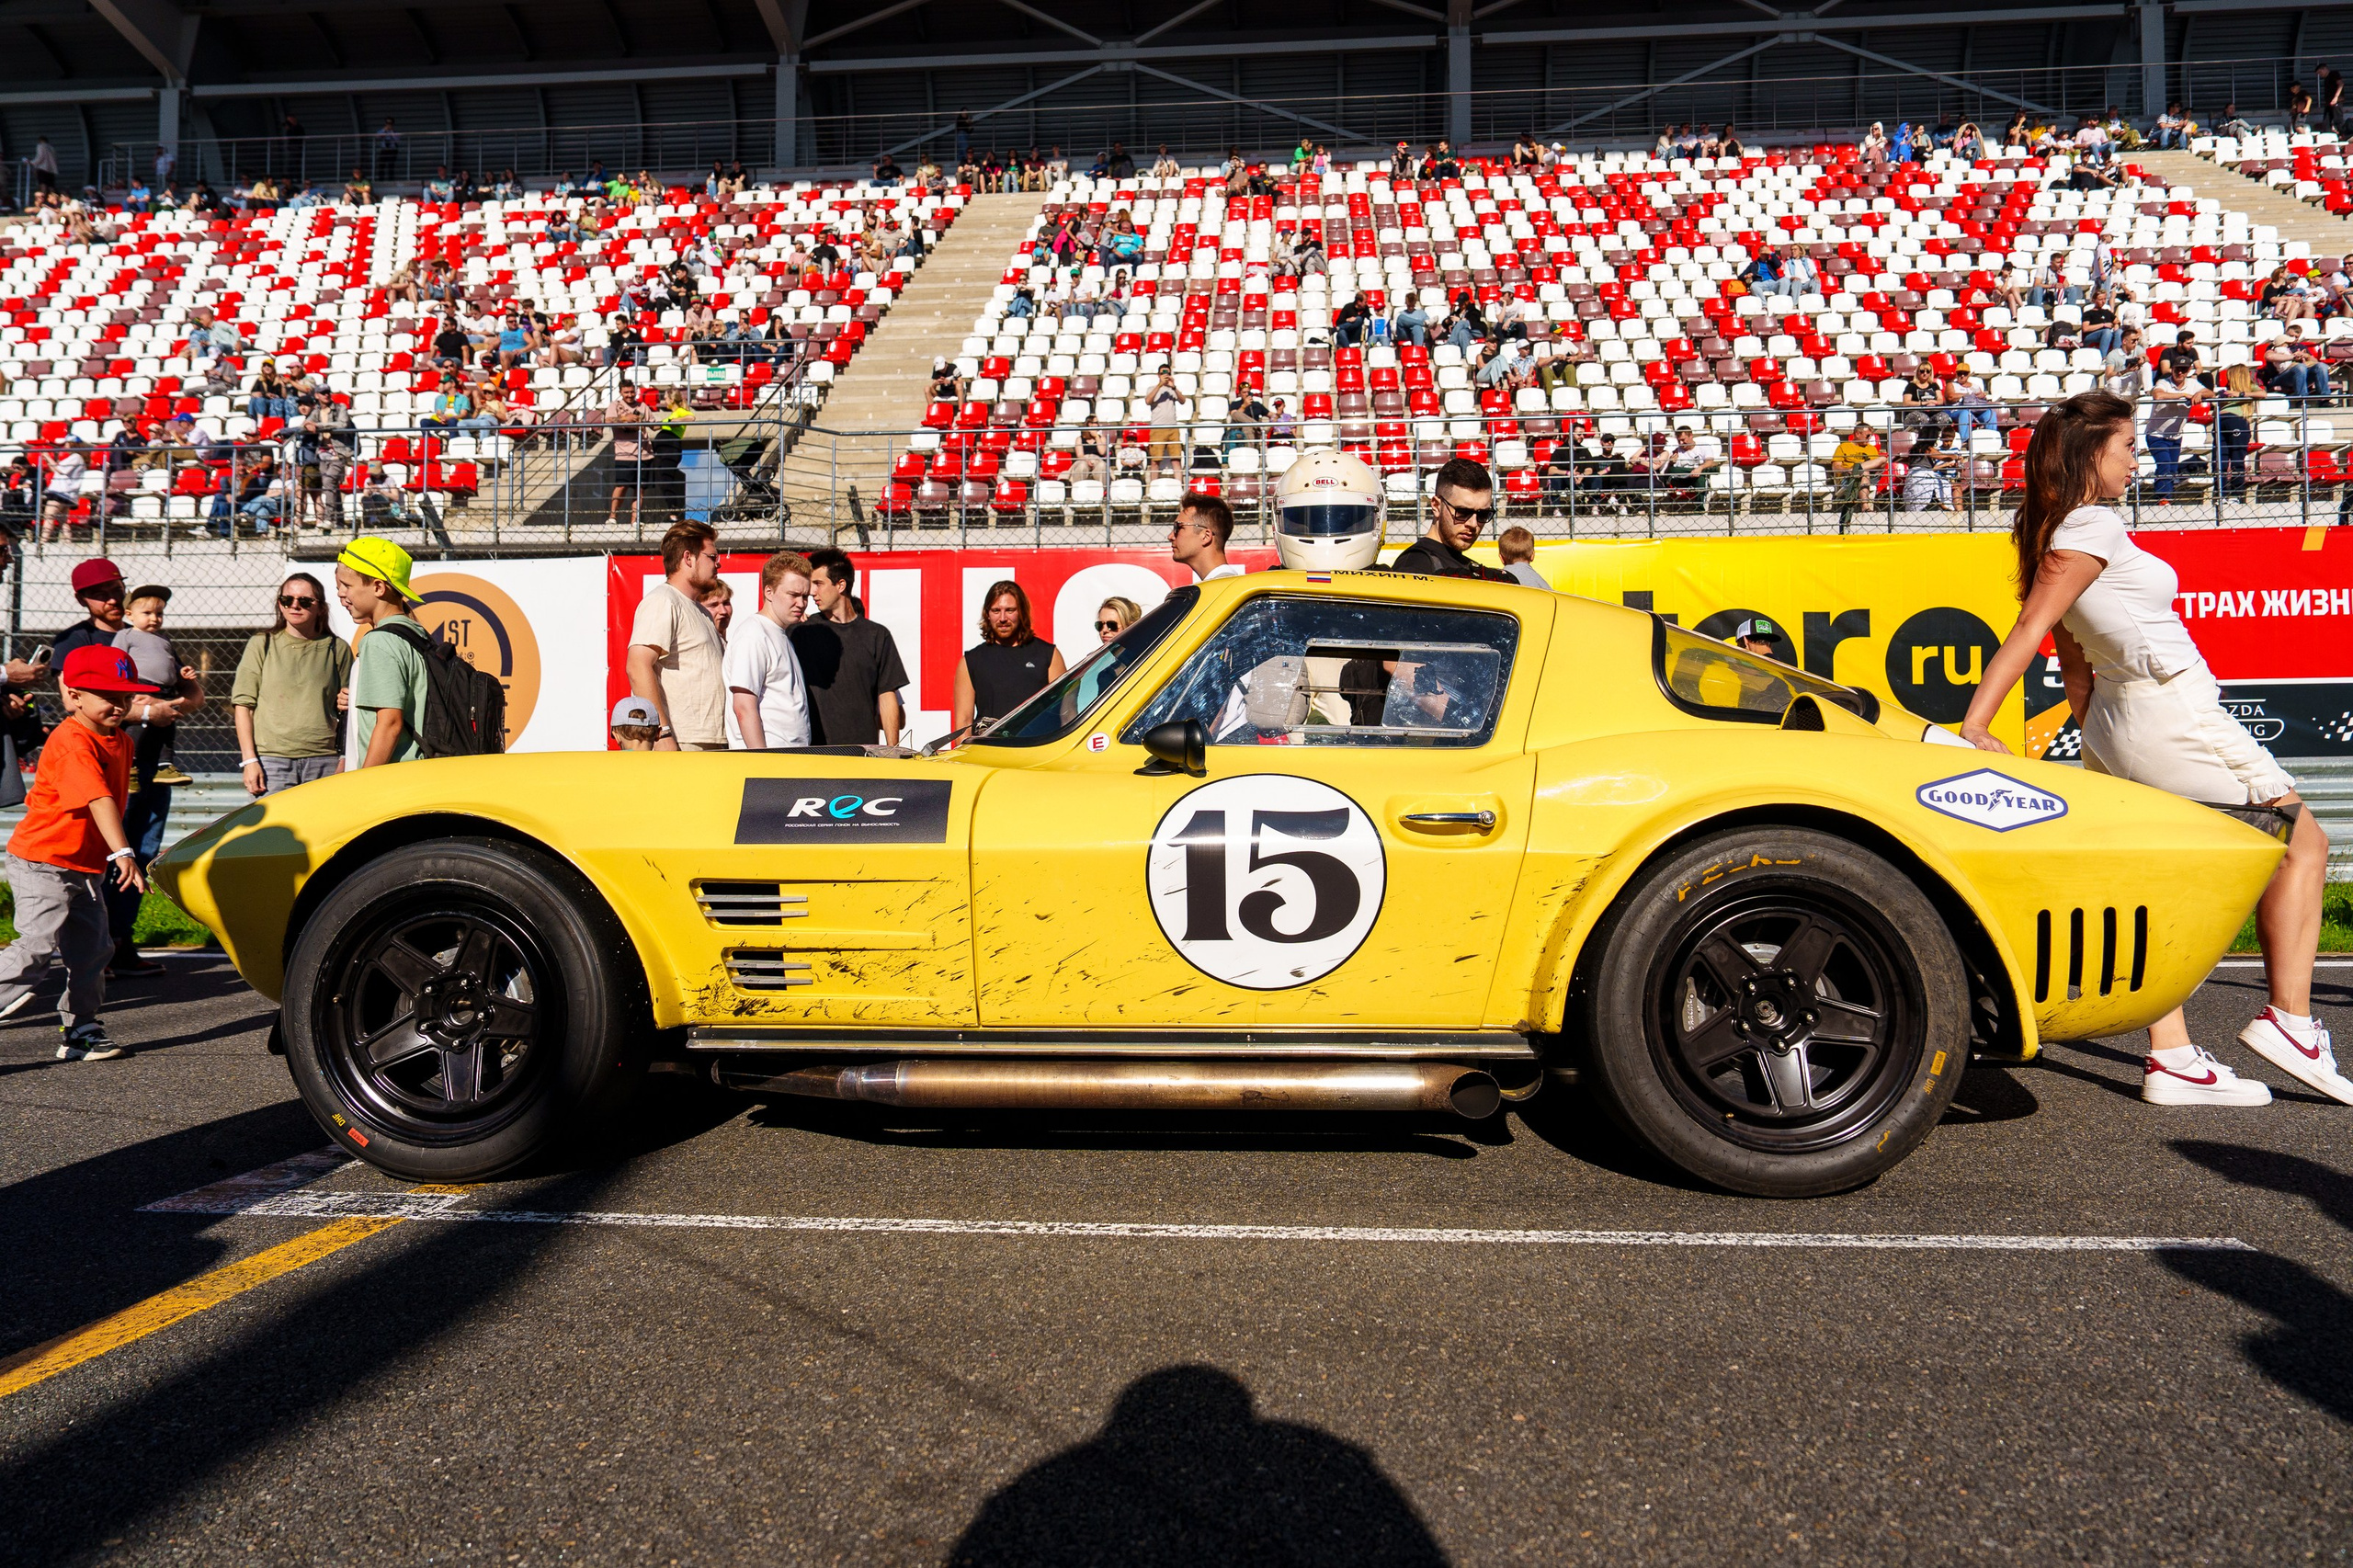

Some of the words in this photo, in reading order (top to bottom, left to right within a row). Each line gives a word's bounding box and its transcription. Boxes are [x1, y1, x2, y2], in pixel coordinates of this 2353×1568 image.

[2175, 591, 2256, 619] ТРАХ
[2260, 588, 2353, 617] ЖИЗН
[1911, 645, 1983, 685] ru
[1092, 736, 1105, 749] E
[1165, 807, 1360, 943] 15
[332, 1113, 346, 1127] DHF
